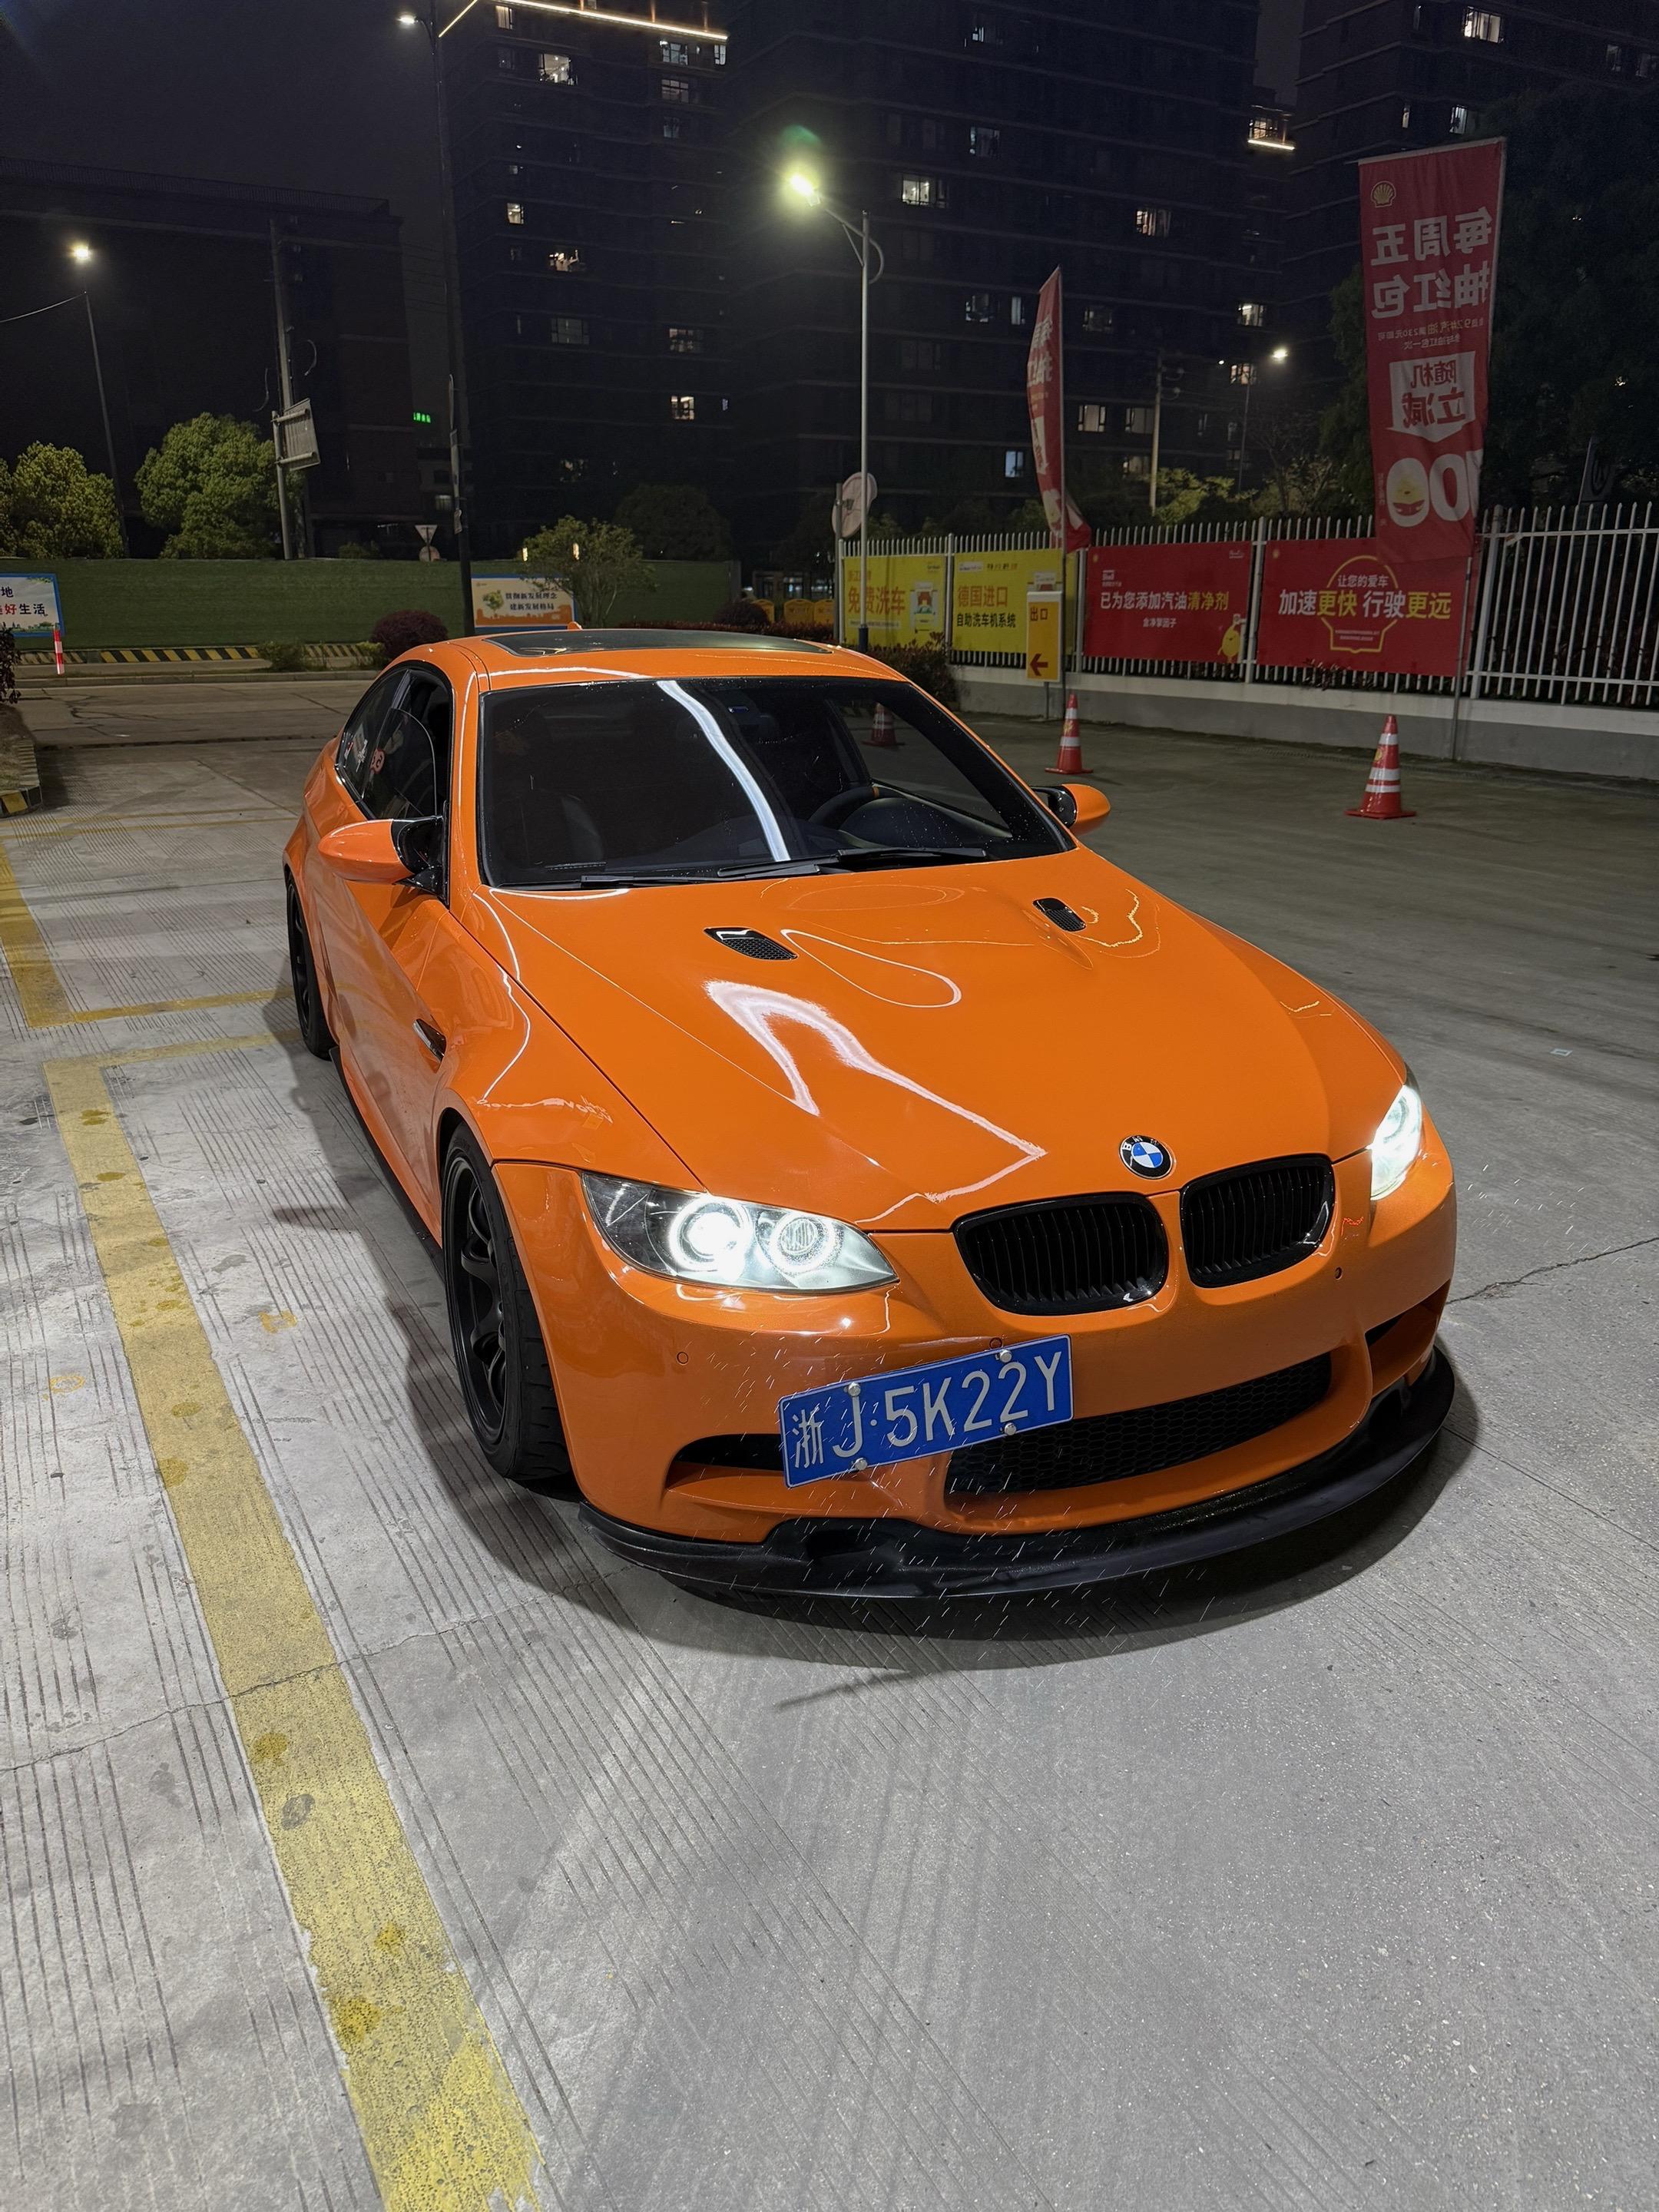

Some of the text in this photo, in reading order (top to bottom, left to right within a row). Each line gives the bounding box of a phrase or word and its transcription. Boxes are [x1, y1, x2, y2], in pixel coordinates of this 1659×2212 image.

[1337, 575, 1389, 588] 让您的爱车
[849, 586, 906, 614] 免费洗车
[959, 585, 1008, 607] 德国进口
[1101, 591, 1229, 611] 已为您添加汽油清净剂
[1278, 588, 1452, 620] 加速更快 行驶更远
[957, 612, 1015, 628] 自助洗车机系统
[1030, 606, 1048, 621] 出口
